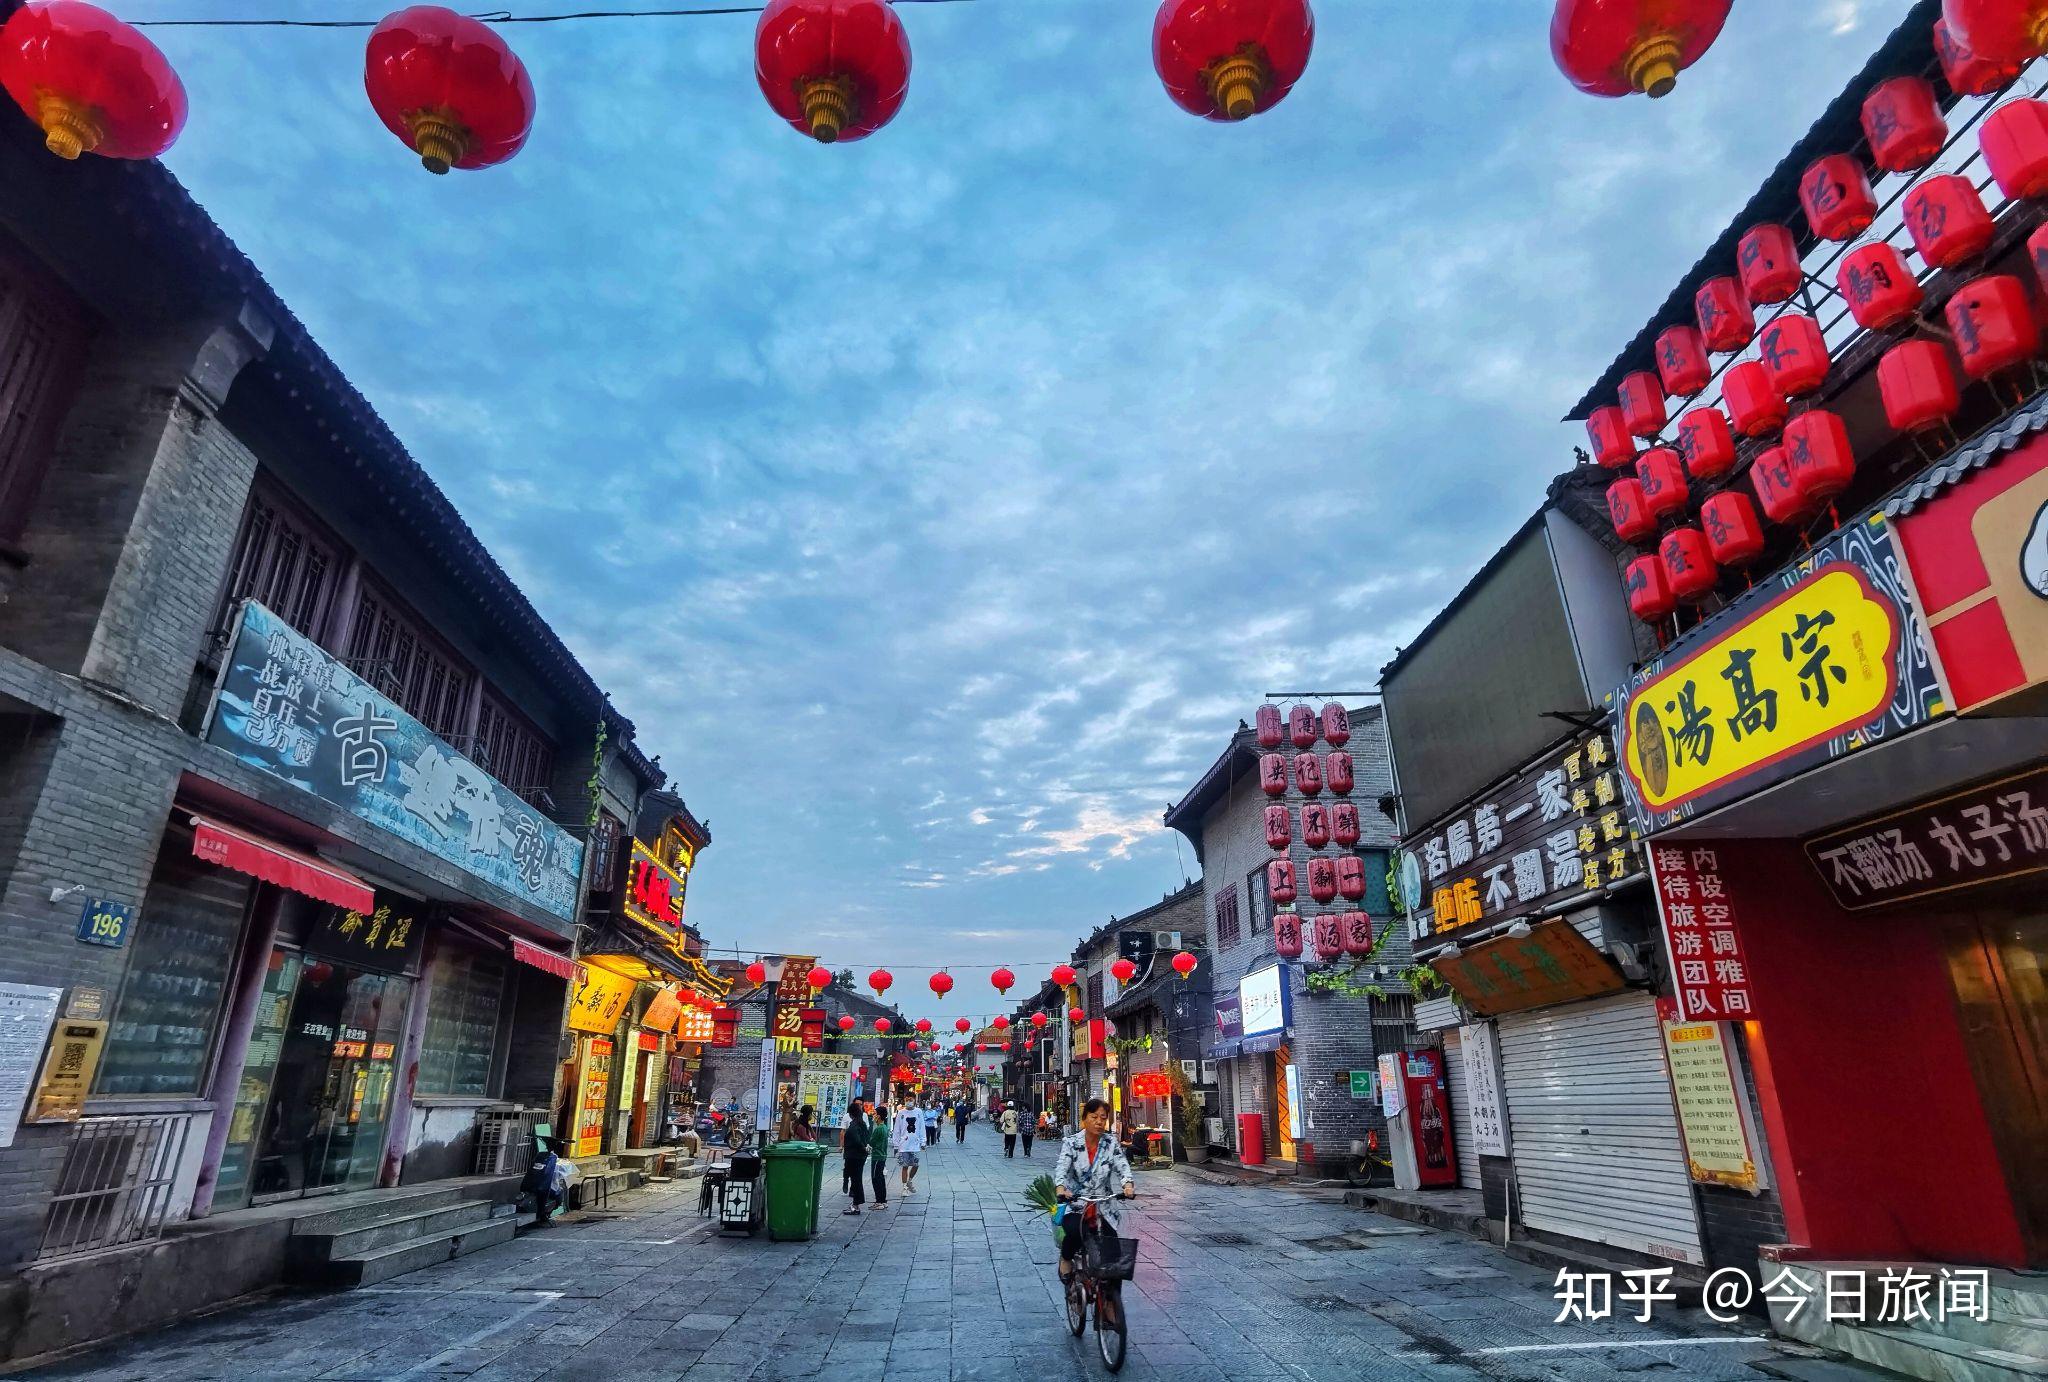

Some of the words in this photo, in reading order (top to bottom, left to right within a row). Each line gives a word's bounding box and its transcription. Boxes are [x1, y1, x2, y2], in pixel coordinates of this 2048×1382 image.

[1425, 769, 1571, 880] 洛陽第一家
[1564, 751, 1600, 889] 百年老店
[1818, 828, 1933, 895] 不翻汤
[1929, 791, 2048, 872] 丸子汤
[92, 913, 122, 939] 196
[1657, 848, 1718, 1014] 接待旅游团队
[1691, 848, 1752, 1014] 内设空调雅间
